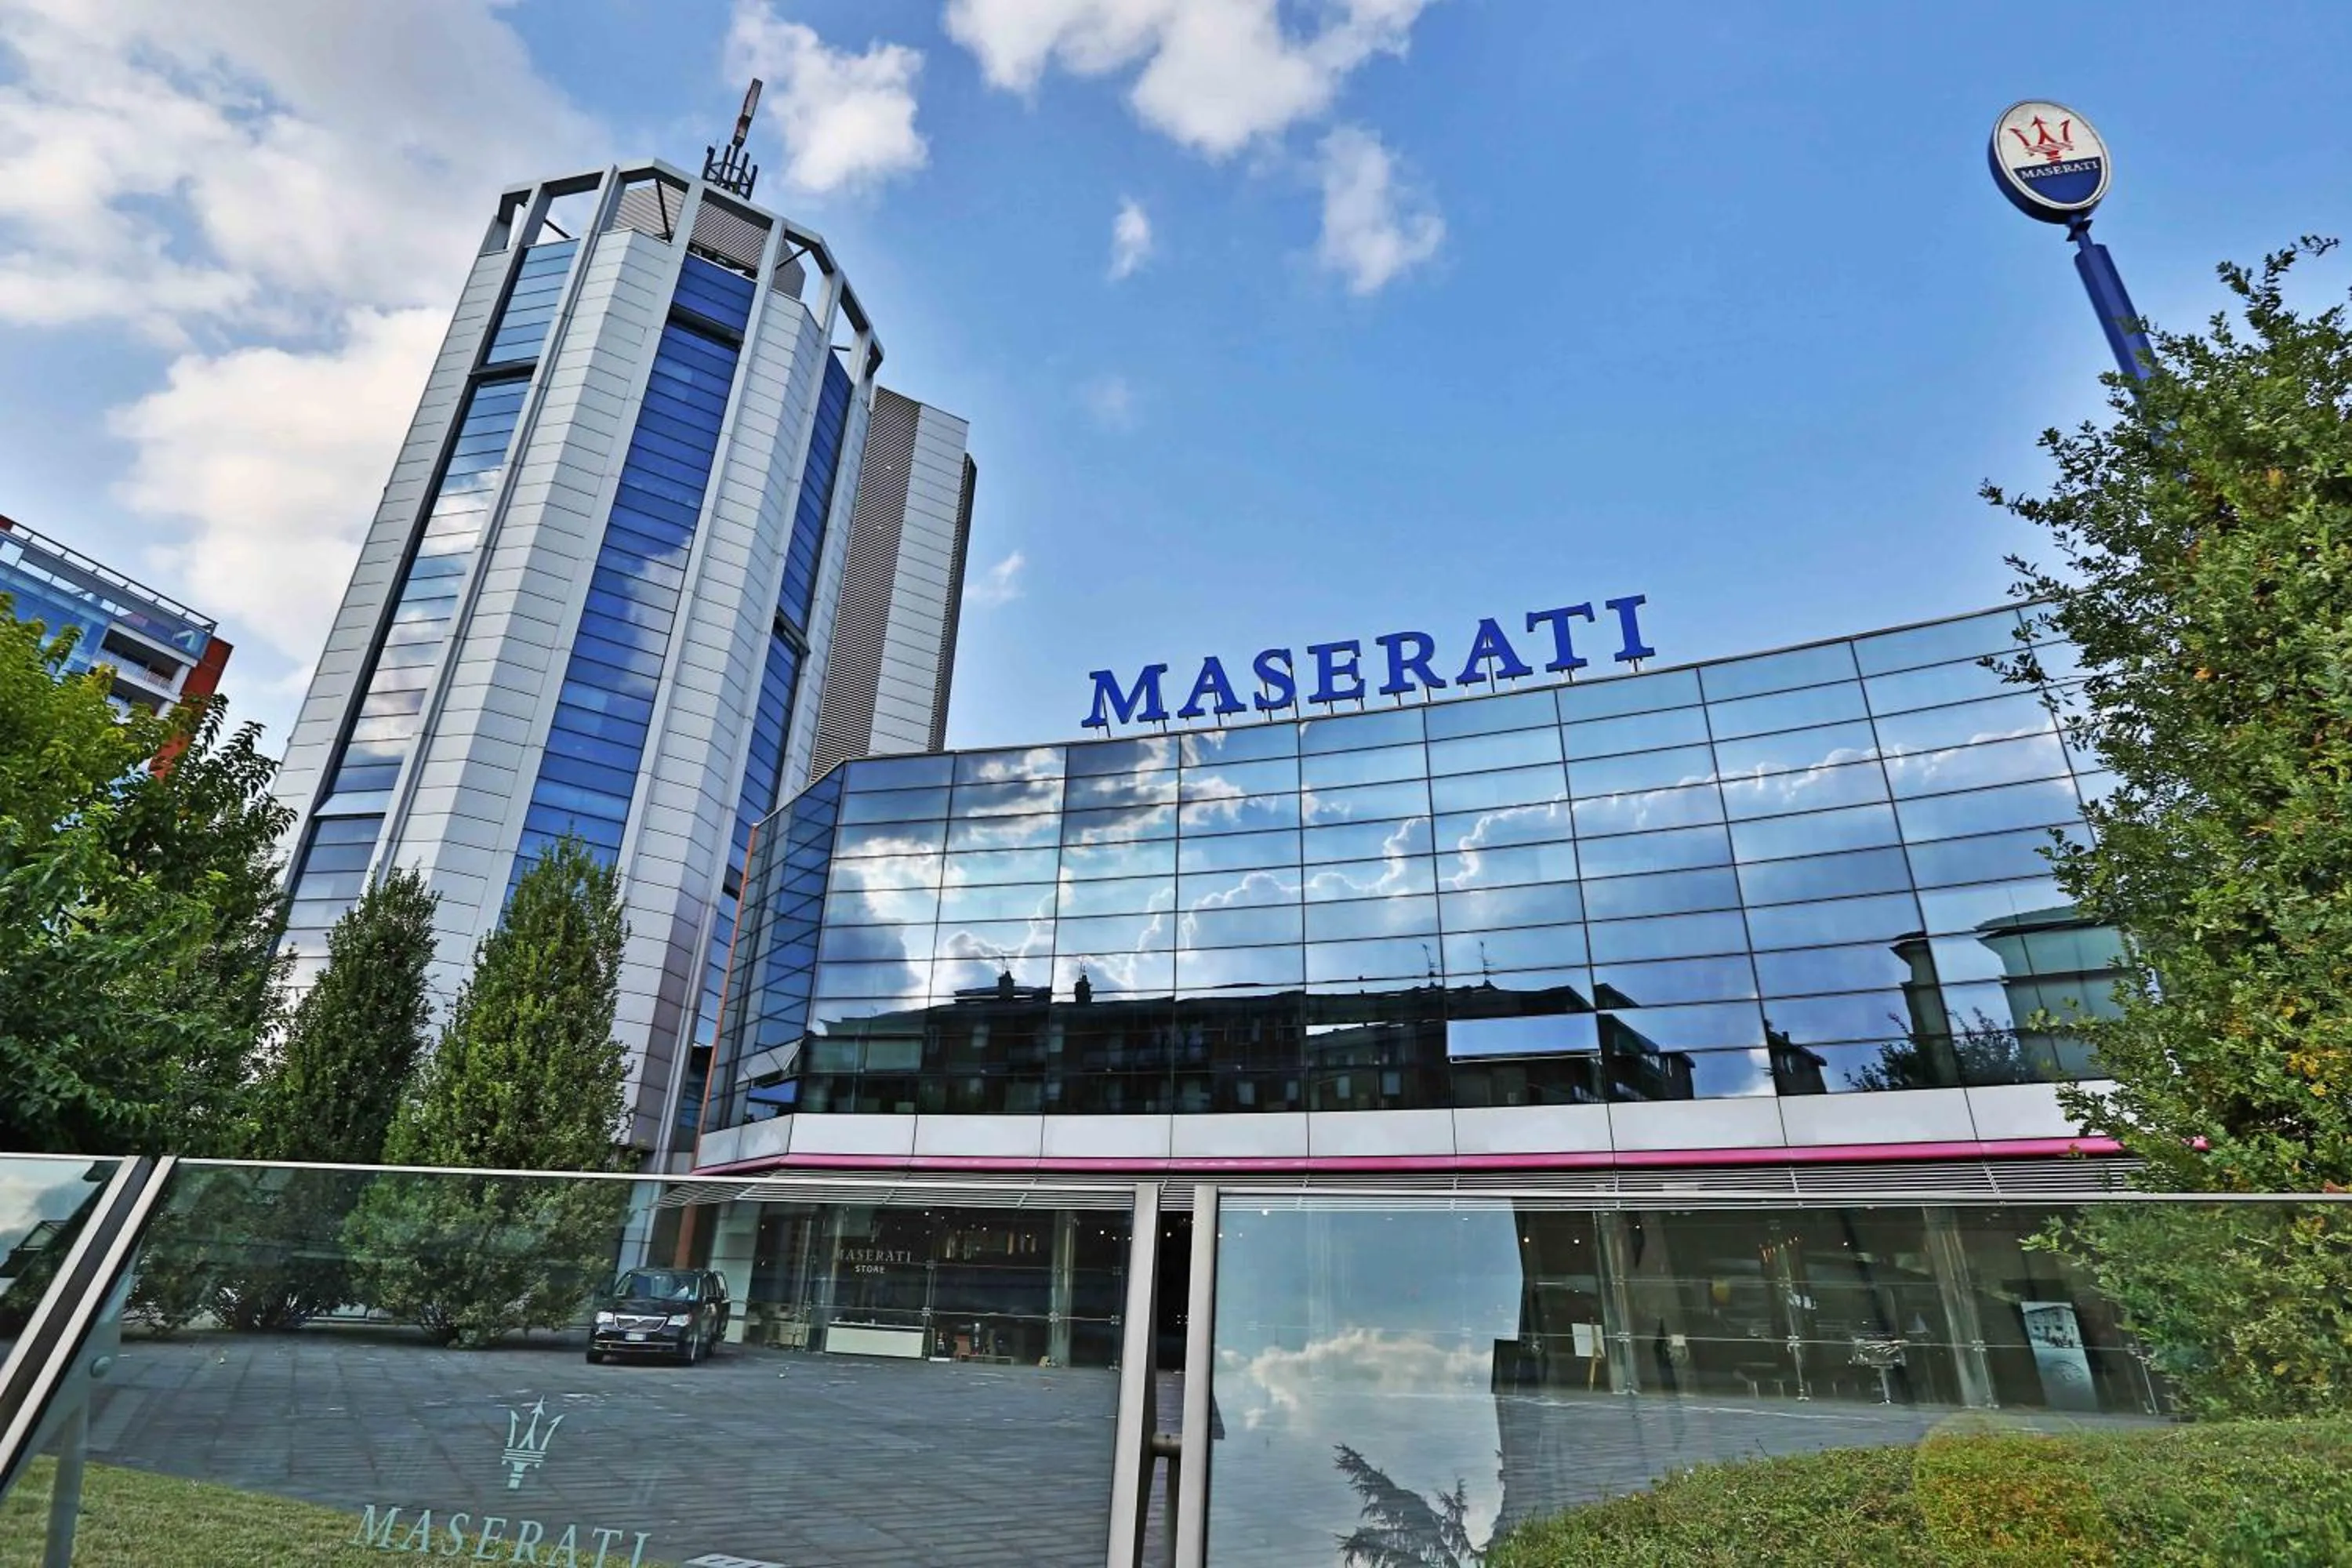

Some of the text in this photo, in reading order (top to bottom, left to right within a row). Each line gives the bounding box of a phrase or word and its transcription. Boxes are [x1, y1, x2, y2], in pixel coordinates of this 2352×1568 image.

[2023, 161, 2098, 179] MASERATI
[1081, 594, 1656, 728] MASERATI
[854, 1265, 886, 1274] STORE
[348, 1504, 652, 1568] MASERATI
